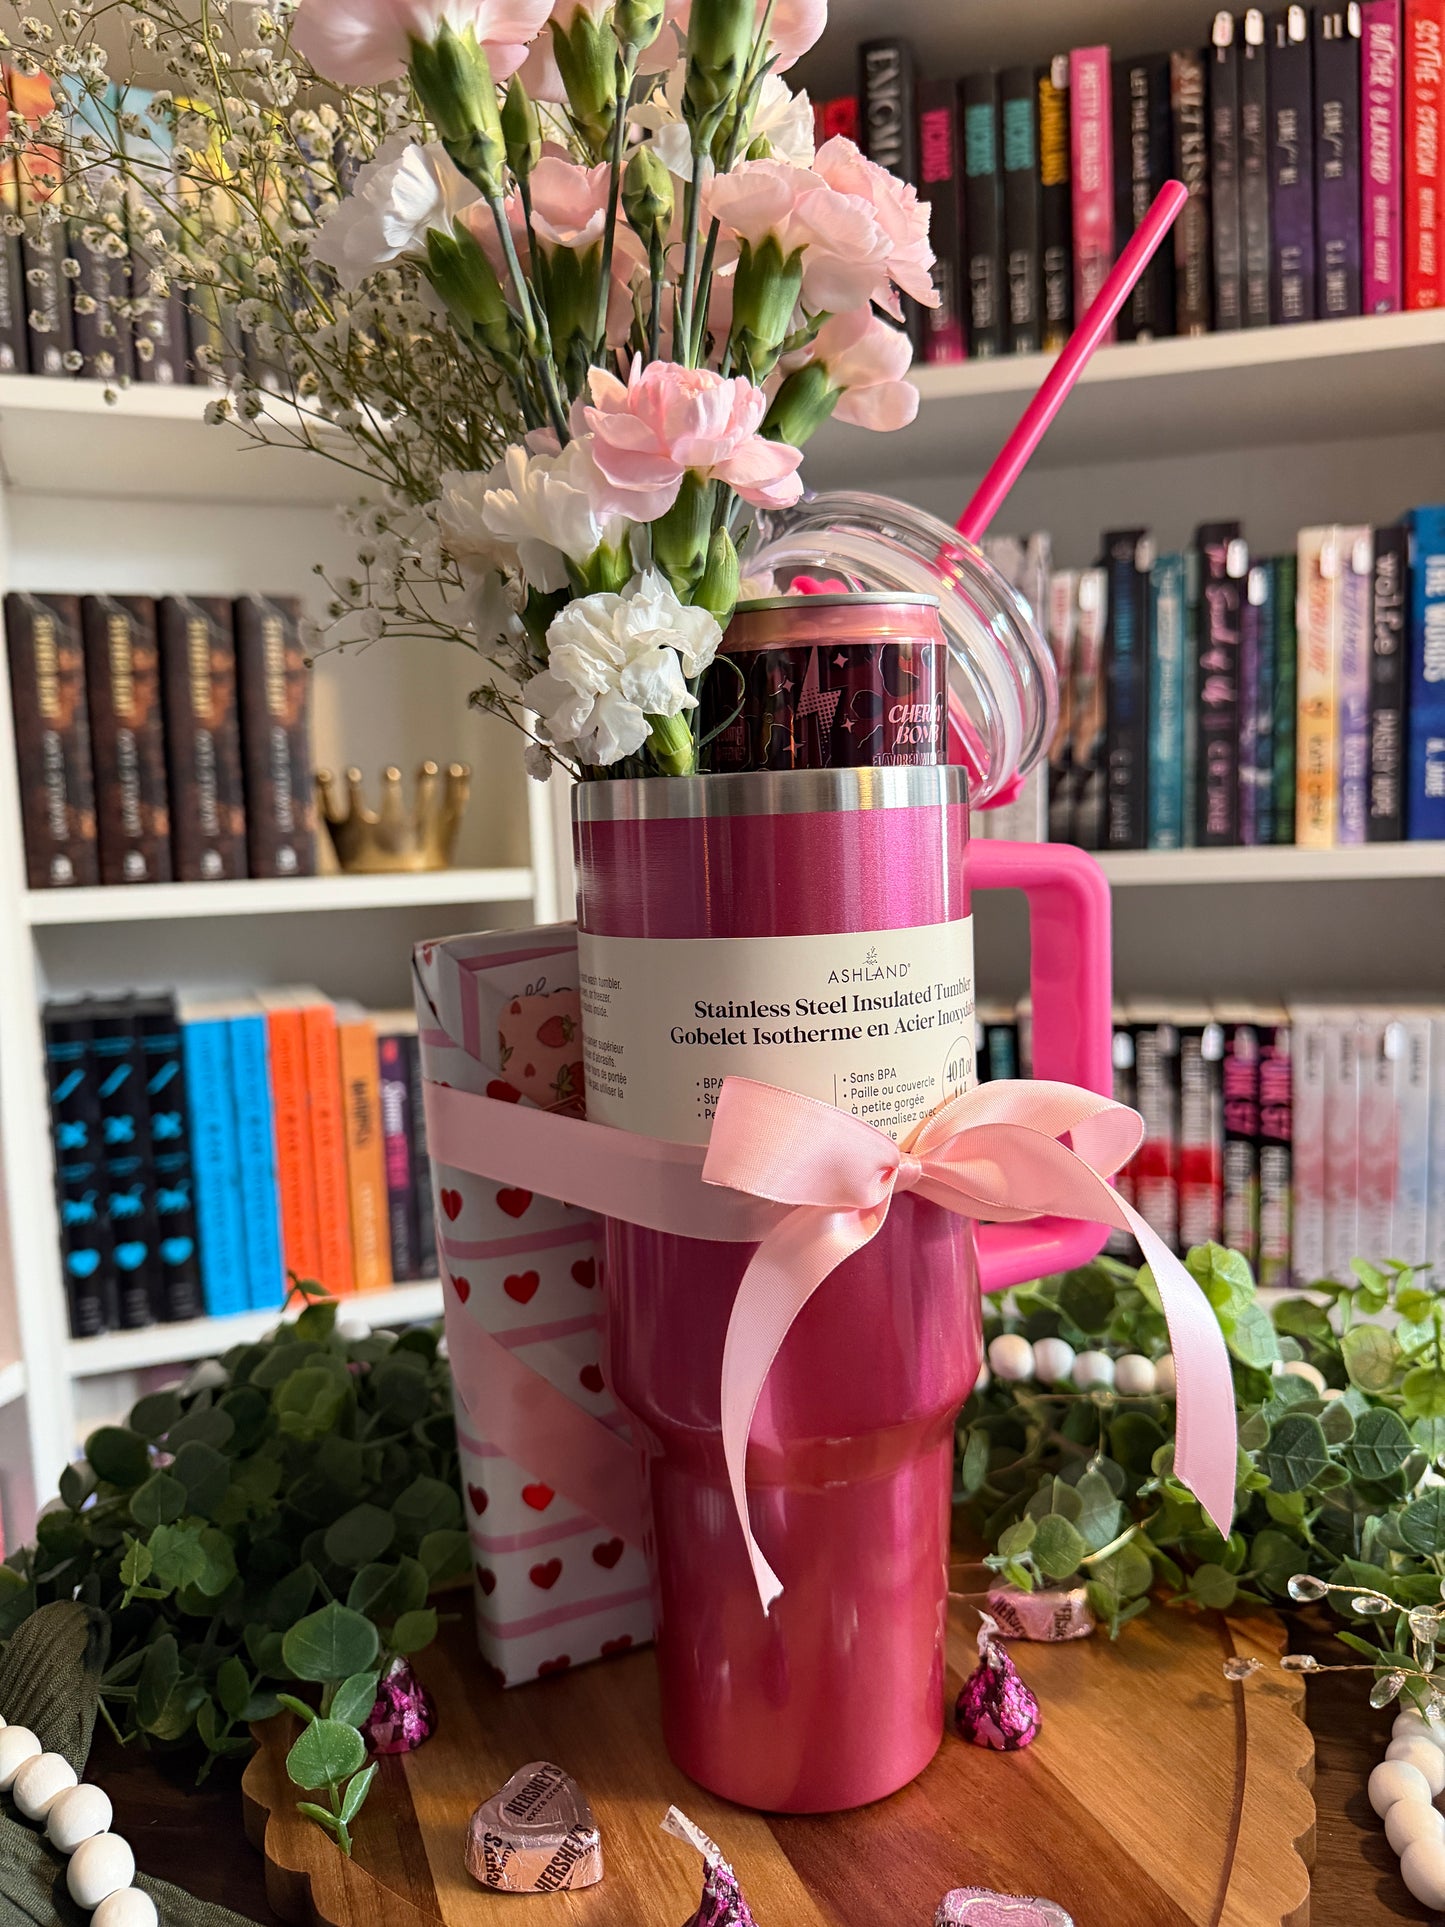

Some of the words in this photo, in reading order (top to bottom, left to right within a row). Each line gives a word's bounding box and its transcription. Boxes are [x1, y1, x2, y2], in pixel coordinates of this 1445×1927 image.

[1370, 23, 1396, 88] BUTCHER
[1415, 20, 1441, 83] SCYTHE
[1080, 62, 1099, 116] PRETTY
[1130, 68, 1147, 97] LET
[1180, 64, 1203, 126] SALT
[1132, 99, 1149, 129] THE
[920, 106, 953, 183] VICIOUS
[1080, 120, 1103, 193] RECKLESS
[1132, 132, 1150, 180] GAME
[1370, 106, 1392, 184] BLACKBIRD
[1415, 105, 1437, 178] SPARROW
[1181, 132, 1205, 196] KISS
[896, 725, 939, 745] BOMB
[694, 1000, 791, 1019] Stainless
[795, 997, 848, 1016] Steel
[852, 988, 932, 1013] Insulated
[934, 976, 972, 1002] Tumbler
[598, 1040, 624, 1055] supérieur
[670, 1025, 748, 1048] Gobelet
[752, 1023, 863, 1046] Isotherme
[866, 1023, 890, 1039] en
[893, 1013, 936, 1035] Acier
[607, 1071, 627, 1085] portée
[850, 1071, 872, 1084] Sans
[875, 1068, 898, 1081] BPA
[851, 1086, 879, 1100] Paille
[882, 1086, 894, 1096] ou
[896, 1076, 936, 1094] couvercle
[946, 1060, 958, 1083] 40
[617, 1087, 624, 1099] la
[851, 1102, 858, 1115] à
[861, 1099, 891, 1116] petite
[894, 1094, 925, 1114] gorgée
[867, 1112, 917, 1127] sonnalisez
[919, 1106, 937, 1119] avec
[505, 1764, 562, 1817] HERSHEY'S
[526, 1800, 548, 1822] extra
[534, 1823, 594, 1892] HERSHEY'S
